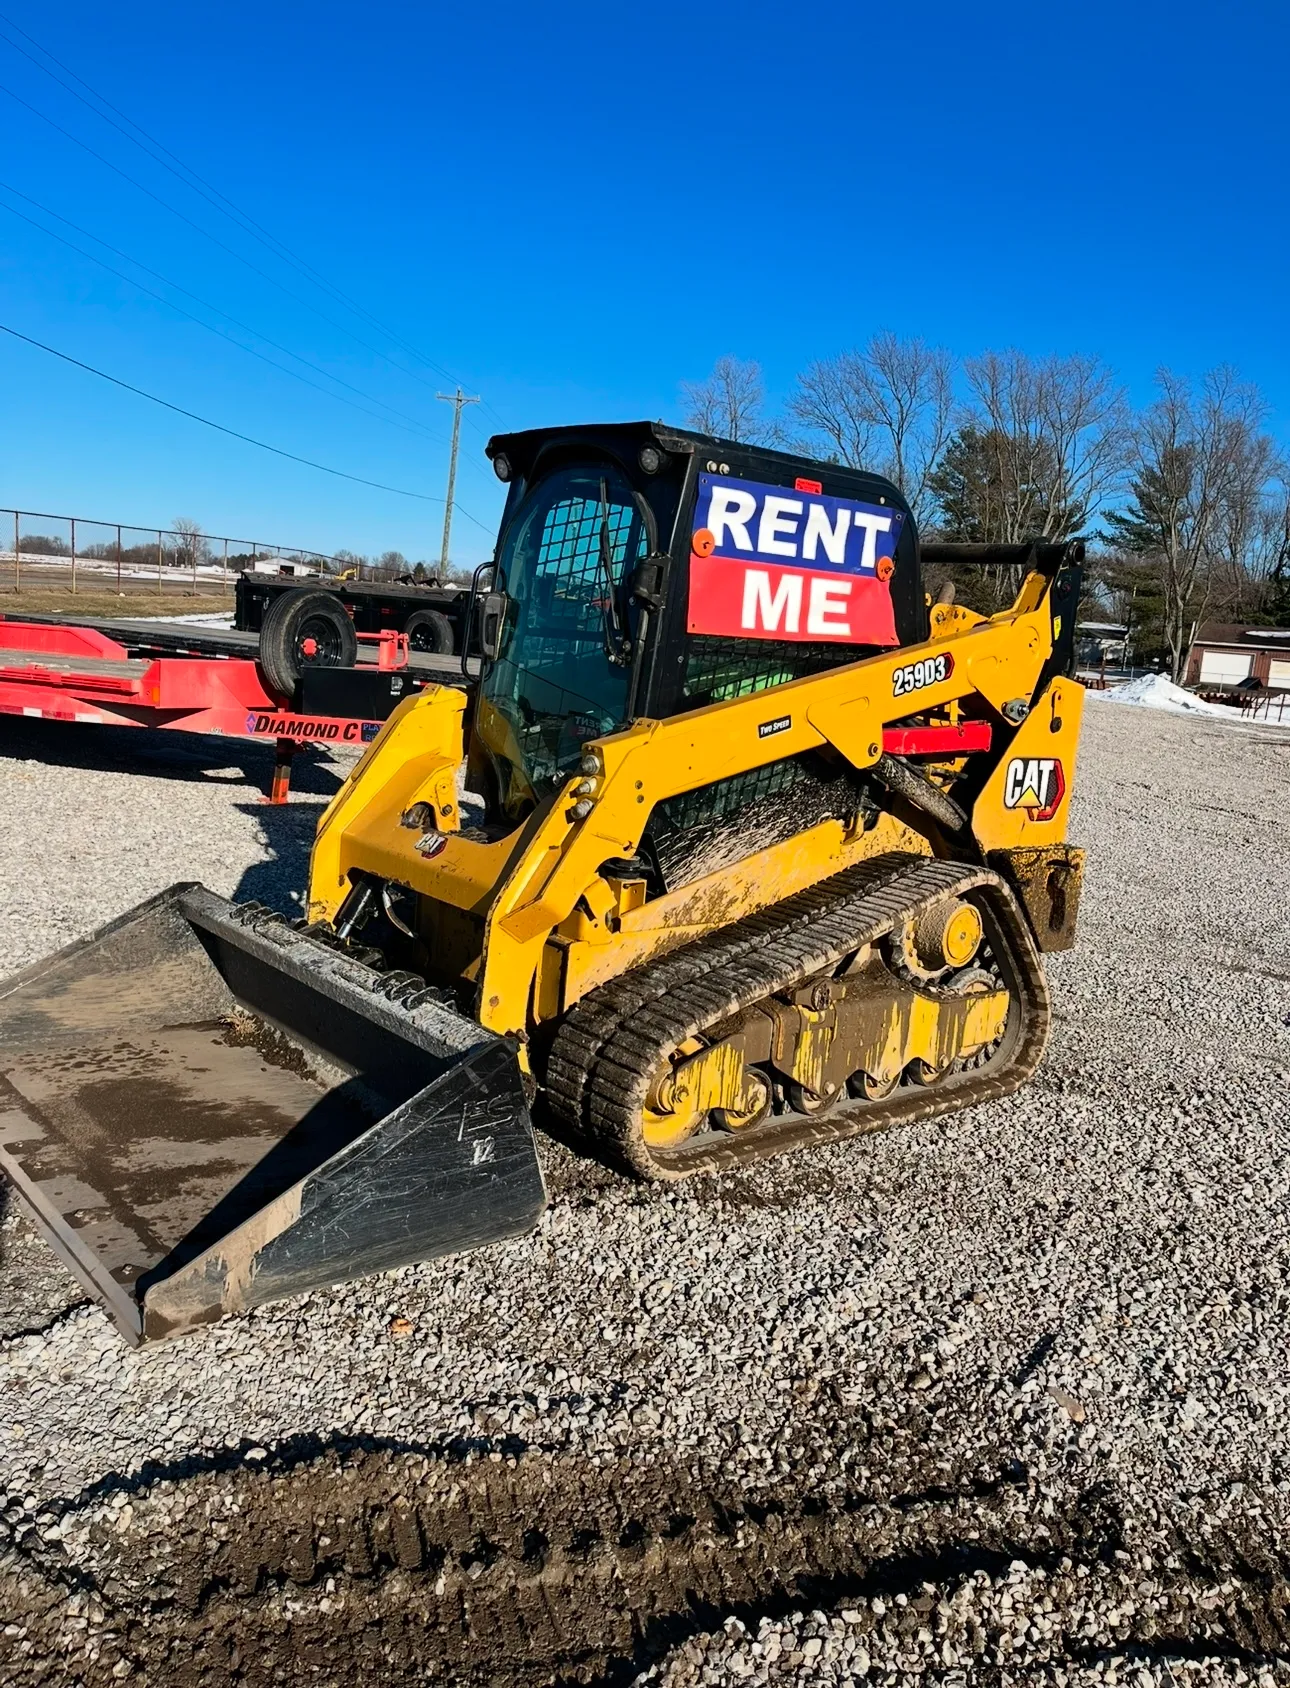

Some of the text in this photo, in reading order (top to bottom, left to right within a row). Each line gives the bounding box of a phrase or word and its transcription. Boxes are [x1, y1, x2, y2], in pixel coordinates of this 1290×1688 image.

[707, 485, 891, 568] RENT
[741, 569, 852, 636] ME
[893, 655, 945, 696] 259D3
[254, 715, 359, 740] DIAMOND C
[1004, 758, 1055, 810] CAT
[414, 832, 446, 854] CAT
